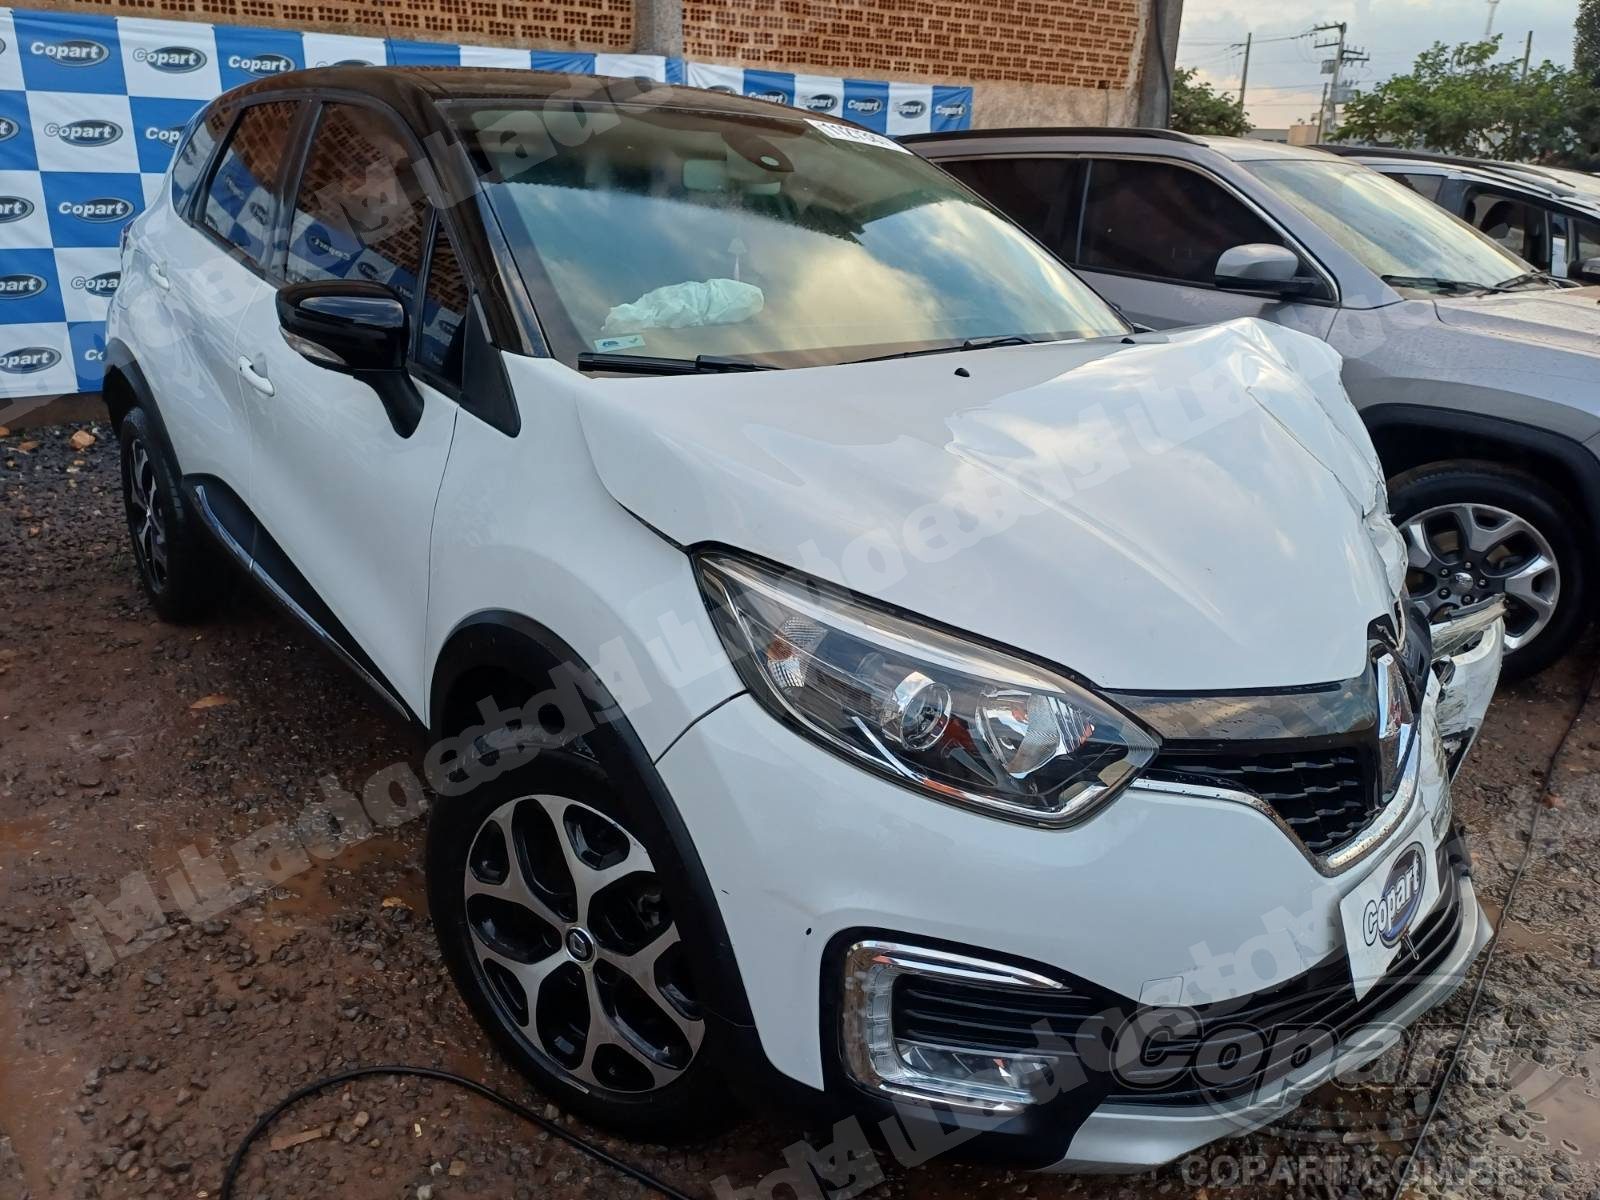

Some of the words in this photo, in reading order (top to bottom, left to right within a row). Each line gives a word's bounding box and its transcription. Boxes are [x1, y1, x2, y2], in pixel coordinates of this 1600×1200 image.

[31, 41, 99, 58] Copart
[132, 47, 197, 66] Copart
[228, 55, 287, 72] Copart
[847, 100, 879, 113] Copart
[44, 122, 112, 140] Copart
[145, 127, 180, 142] Cop
[58, 201, 123, 218] Copart
[71, 276, 119, 291] Copa
[0, 352, 50, 368] opart
[1363, 849, 1420, 946] Copart
